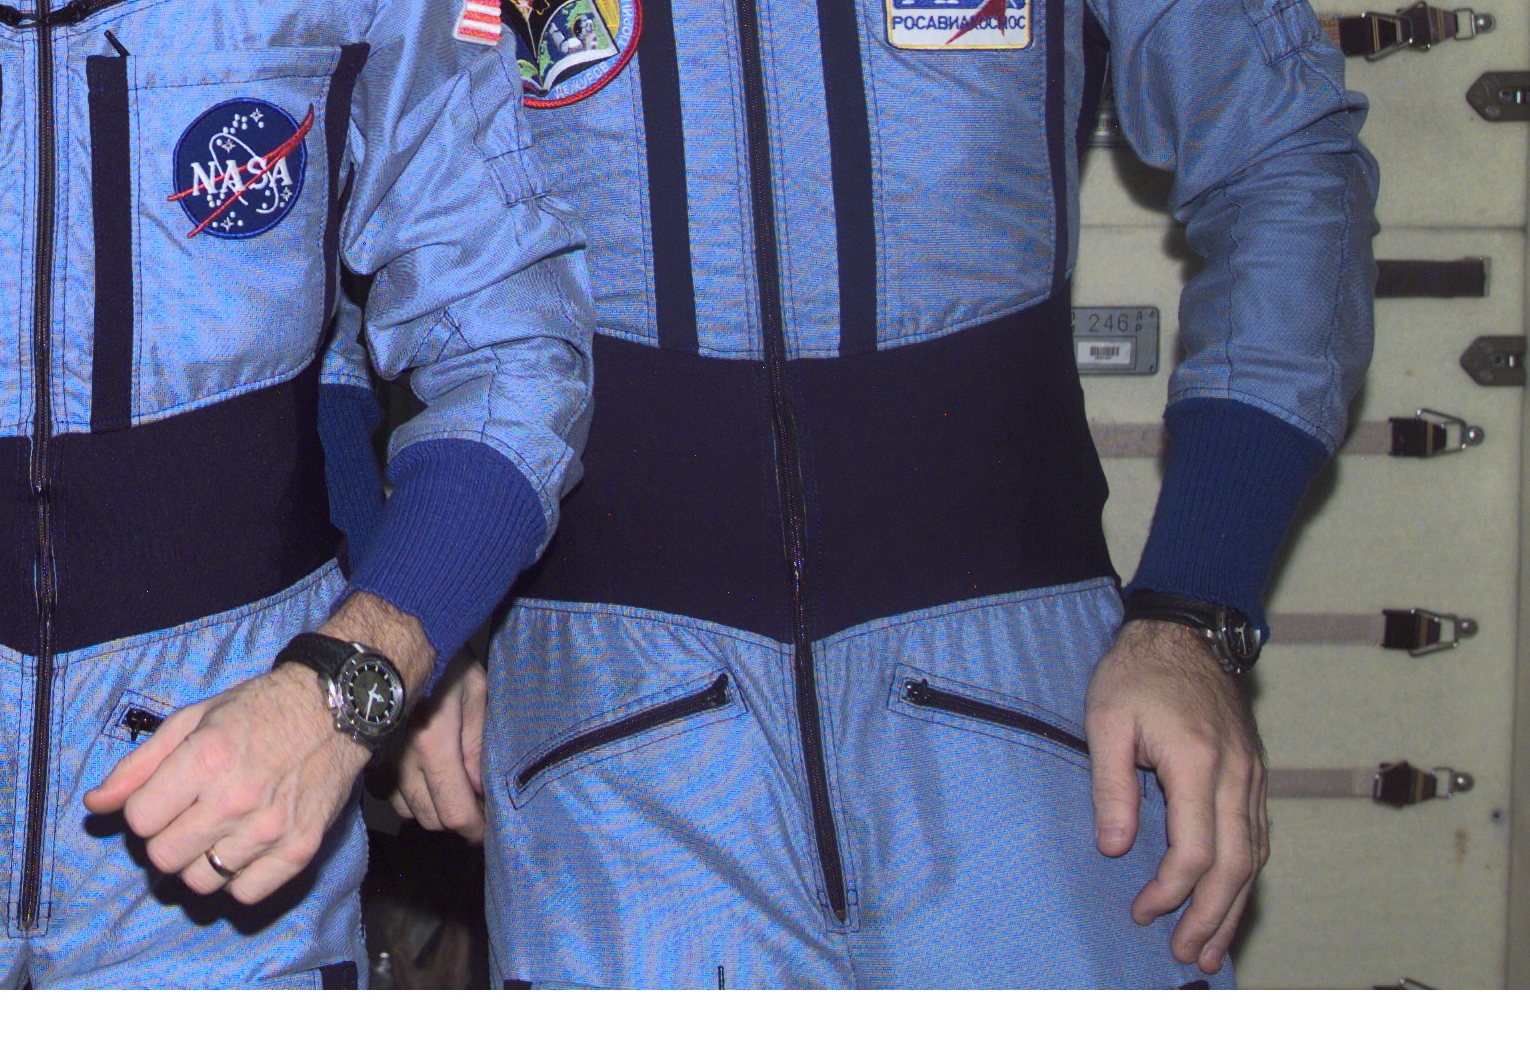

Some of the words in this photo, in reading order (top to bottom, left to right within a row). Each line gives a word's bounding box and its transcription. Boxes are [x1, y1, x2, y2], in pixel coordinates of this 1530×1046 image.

[554, 61, 609, 100] ДЕЖУРОВ
[190, 156, 293, 196] NASA
[1088, 313, 1129, 333] 246
